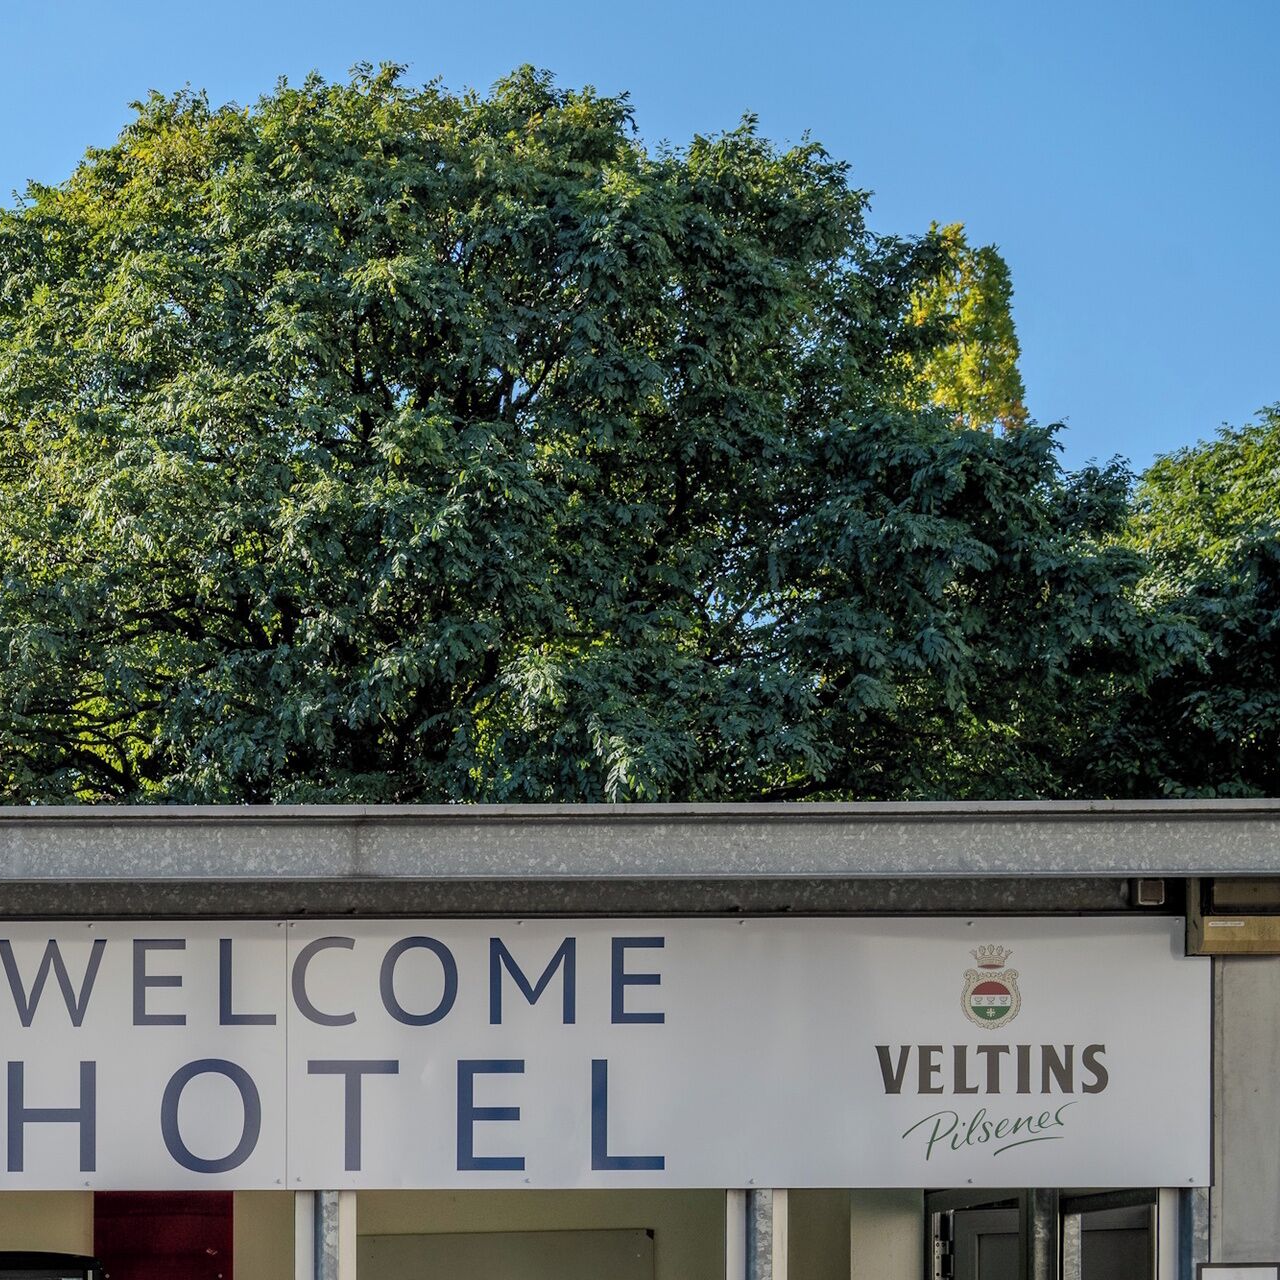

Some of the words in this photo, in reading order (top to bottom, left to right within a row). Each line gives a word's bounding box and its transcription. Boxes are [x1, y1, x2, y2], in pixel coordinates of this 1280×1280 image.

[874, 1044, 1109, 1094] VELTINS
[7, 1058, 665, 1173] HOTEL
[902, 1101, 1078, 1161] Pilsener
